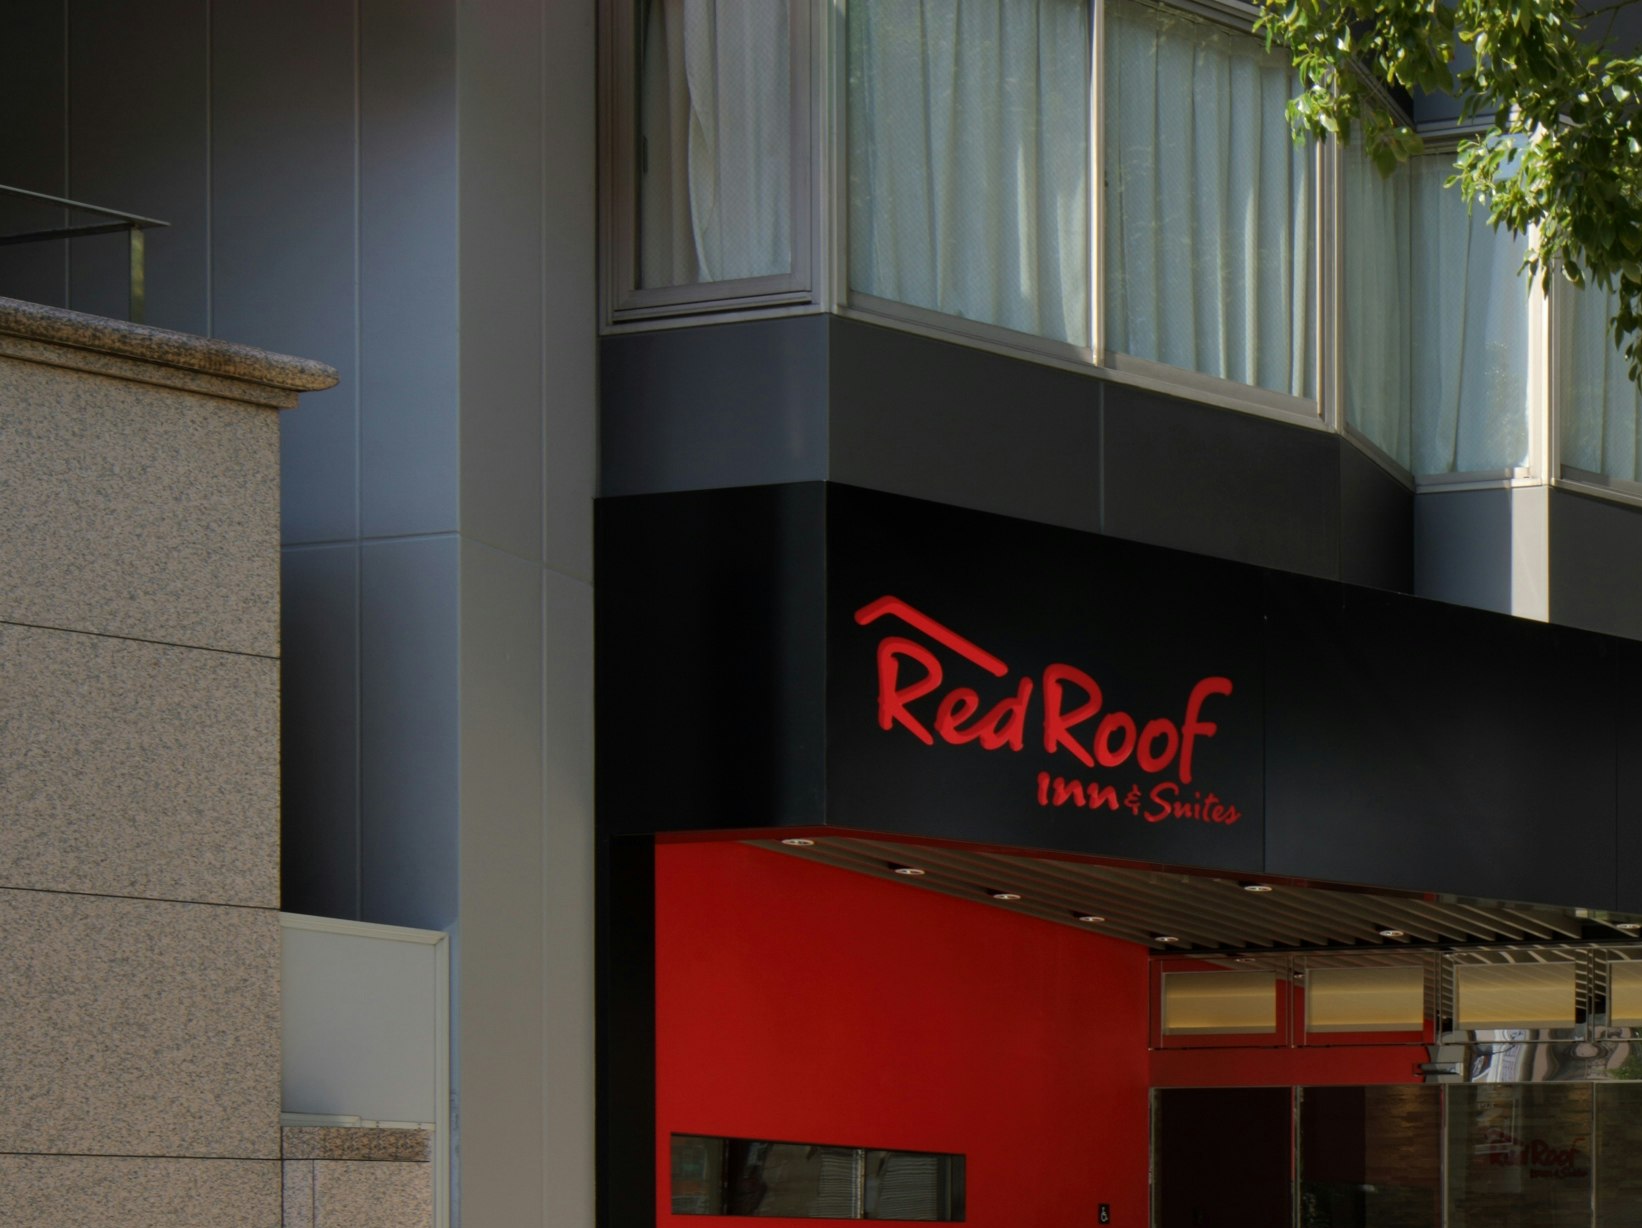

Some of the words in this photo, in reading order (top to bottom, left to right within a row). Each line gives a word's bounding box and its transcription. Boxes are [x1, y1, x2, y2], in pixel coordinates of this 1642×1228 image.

[876, 636, 1034, 752] Red
[1042, 663, 1234, 784] Roof
[1037, 771, 1120, 811] Inn
